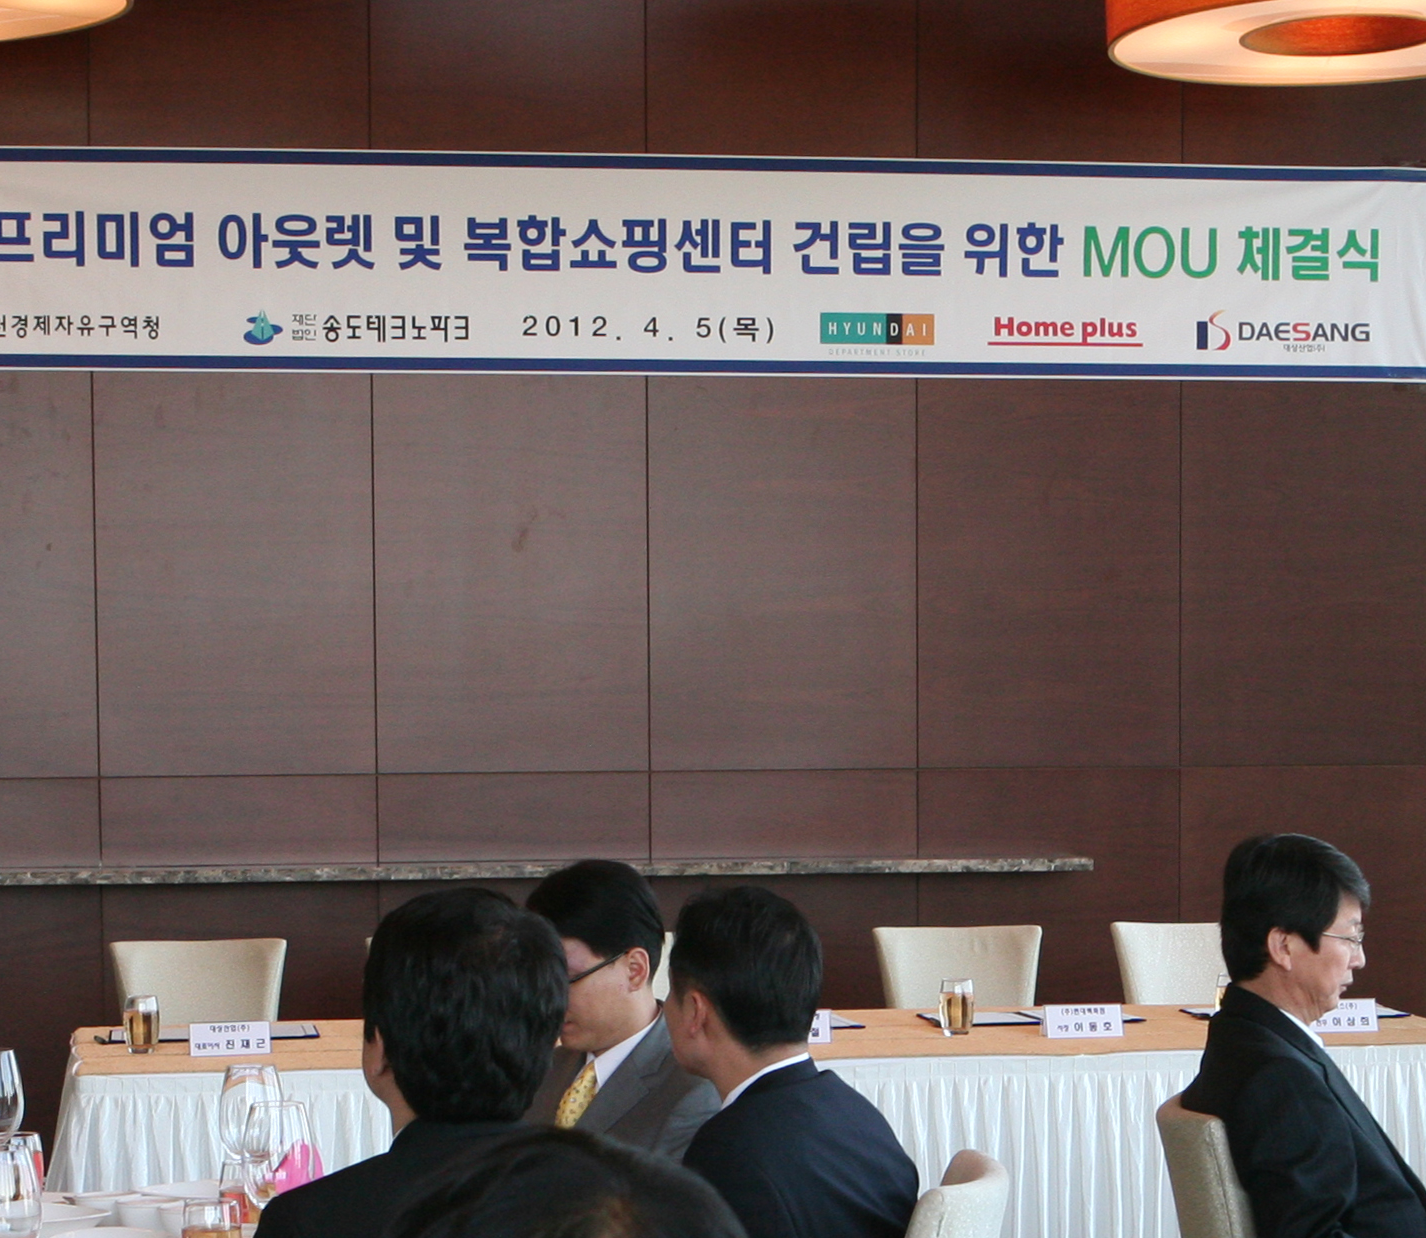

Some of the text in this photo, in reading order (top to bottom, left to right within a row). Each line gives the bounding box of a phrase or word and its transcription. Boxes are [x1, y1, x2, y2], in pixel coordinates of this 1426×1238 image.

[218, 212, 375, 270] 아웃렛
[394, 214, 443, 271] 및
[463, 215, 773, 275] 복합쇼핑센터
[792, 220, 945, 277] 건립을
[964, 222, 1064, 279] 위한
[1083, 225, 1218, 280] MOU
[1237, 226, 1380, 283] 체결식
[292, 313, 317, 326] 재단
[322, 314, 469, 343] 송도테크노파크
[522, 315, 621, 341] 2012.
[828, 321, 927, 337] HYUNDAI
[993, 316, 1137, 343] Home plus
[292, 329, 317, 341] 법인
[1238, 321, 1370, 342] DAESANG
[828, 348, 926, 357] DEPARTMENT STORE
